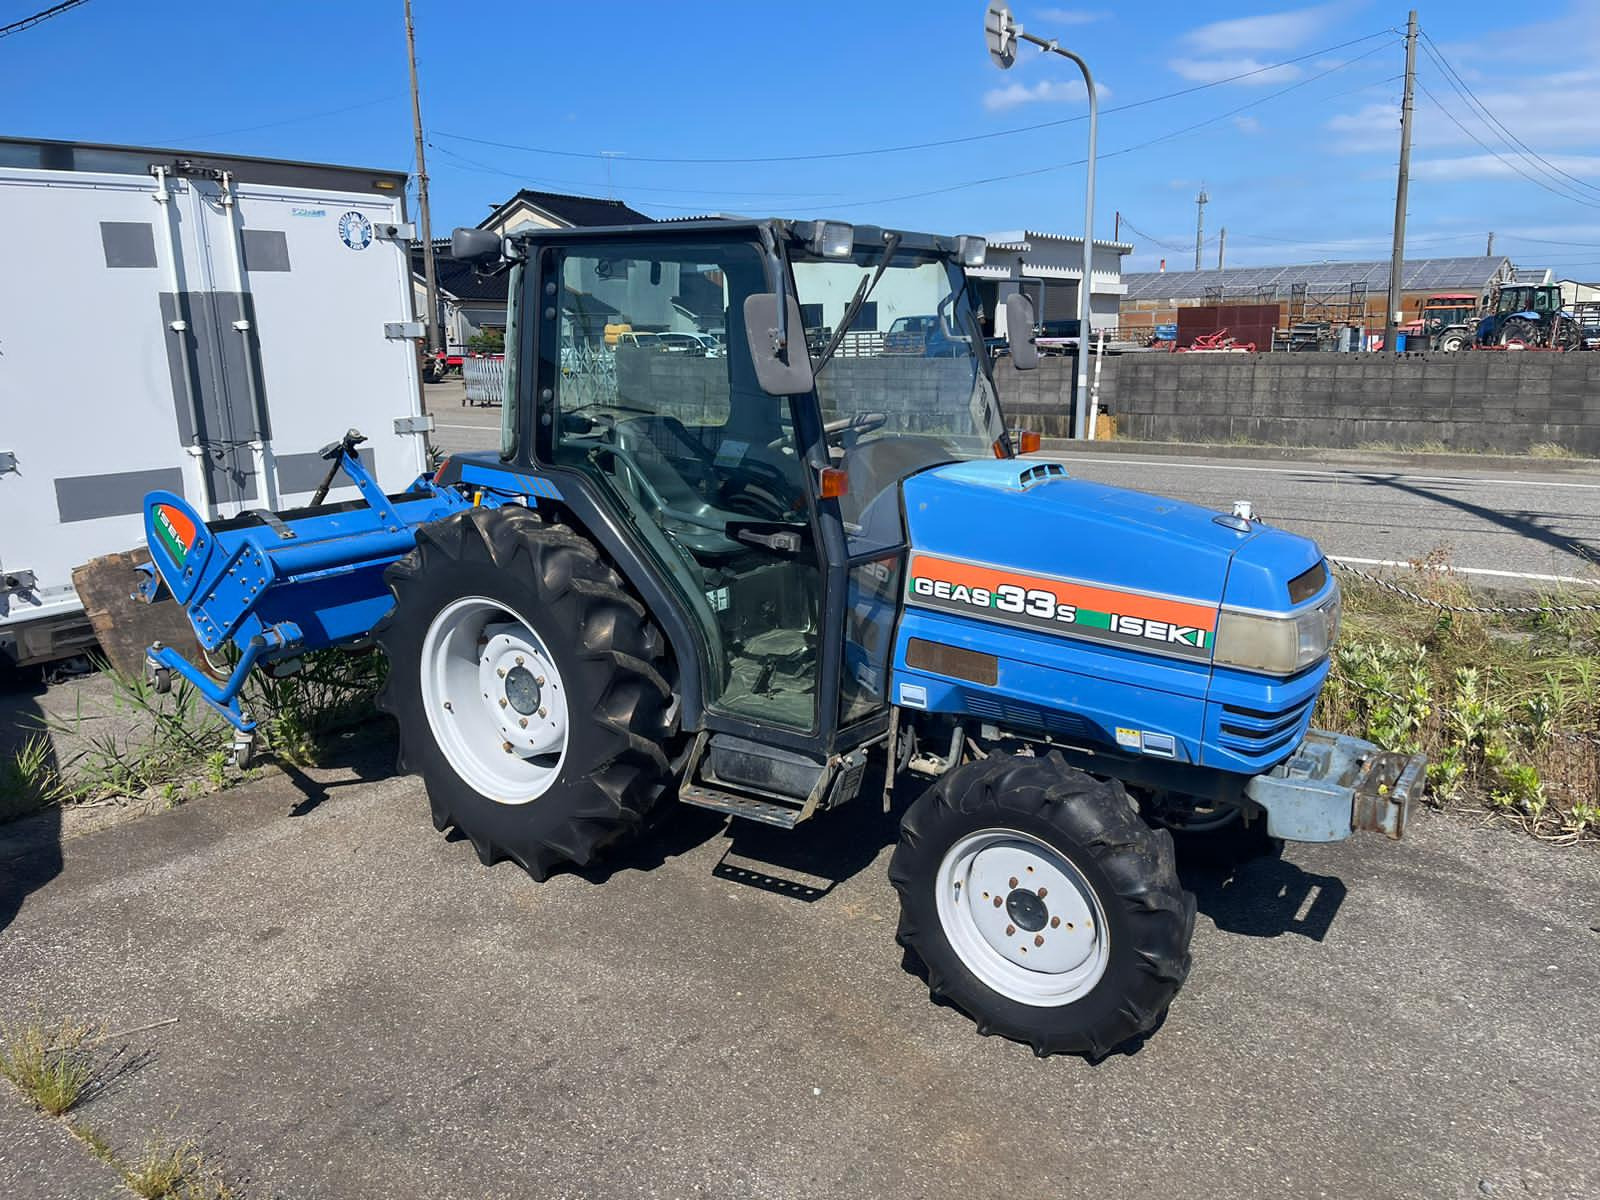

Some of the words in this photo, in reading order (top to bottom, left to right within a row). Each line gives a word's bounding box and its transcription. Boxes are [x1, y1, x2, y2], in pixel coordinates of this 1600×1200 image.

[158, 508, 188, 556] ISEKI
[914, 577, 990, 607] GEAS
[1110, 614, 1206, 648] ISEKI
